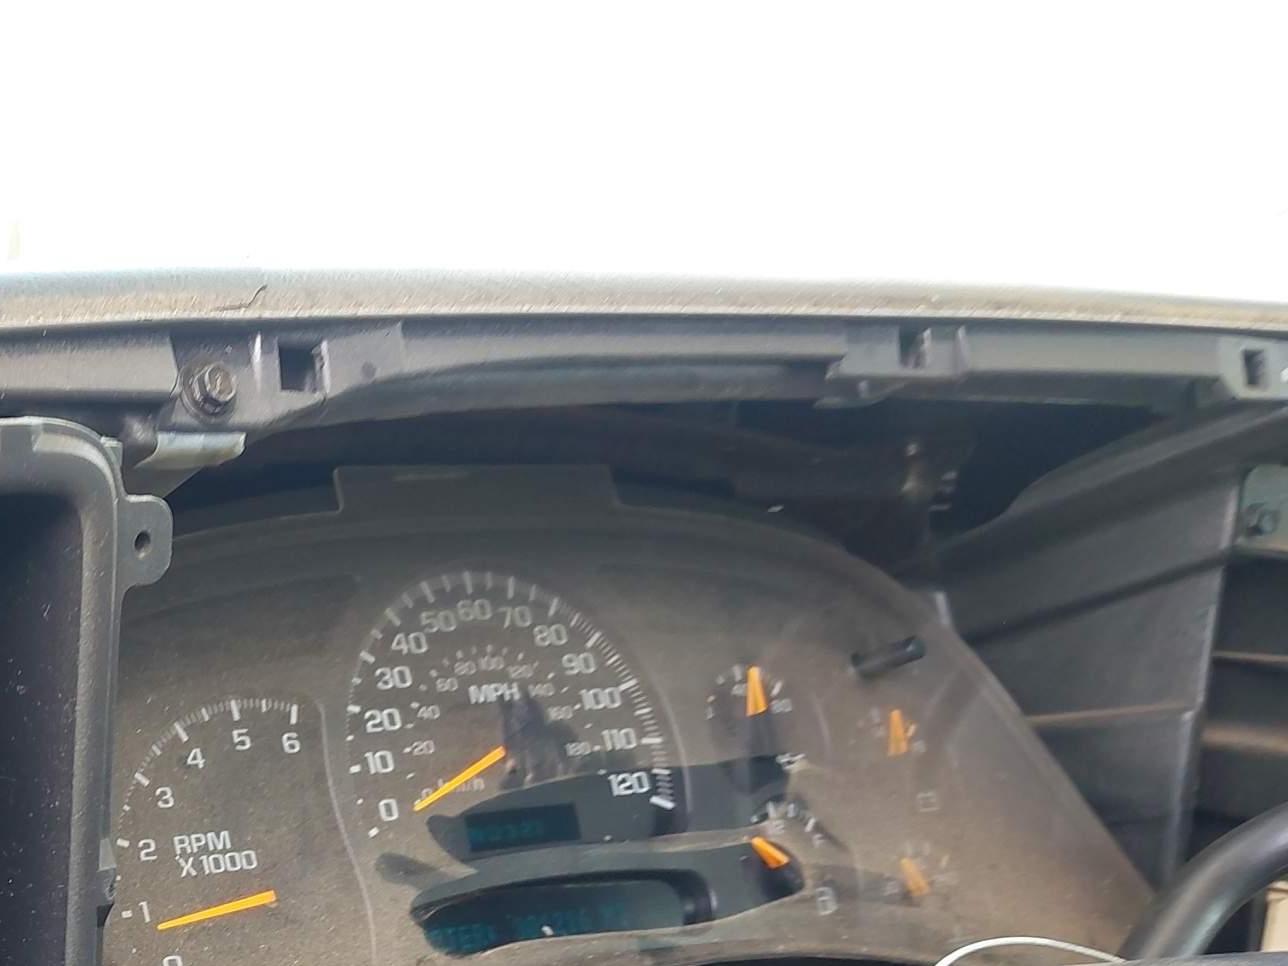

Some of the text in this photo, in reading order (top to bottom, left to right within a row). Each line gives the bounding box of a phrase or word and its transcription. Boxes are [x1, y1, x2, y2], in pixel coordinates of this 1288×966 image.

[420, 610, 457, 633] 50
[457, 599, 492, 621] 60
[498, 606, 532, 628] 70
[391, 632, 429, 655] 40
[533, 624, 569, 647] 80
[562, 652, 597, 675] 90
[375, 666, 412, 690] 30
[468, 682, 521, 704] MPH
[578, 687, 622, 711] 100
[364, 708, 402, 733] 20
[232, 728, 252, 750] 5
[281, 732, 301, 754] 6
[601, 727, 637, 751] 110
[186, 748, 206, 769] 4
[364, 750, 395, 775] 10
[608, 771, 651, 797] 120
[154, 787, 175, 809] 3
[378, 798, 399, 822] 0
[137, 838, 158, 862] 2
[173, 830, 232, 855] RPM
[175, 850, 258, 878] X 1000
[138, 900, 151, 923] 1
